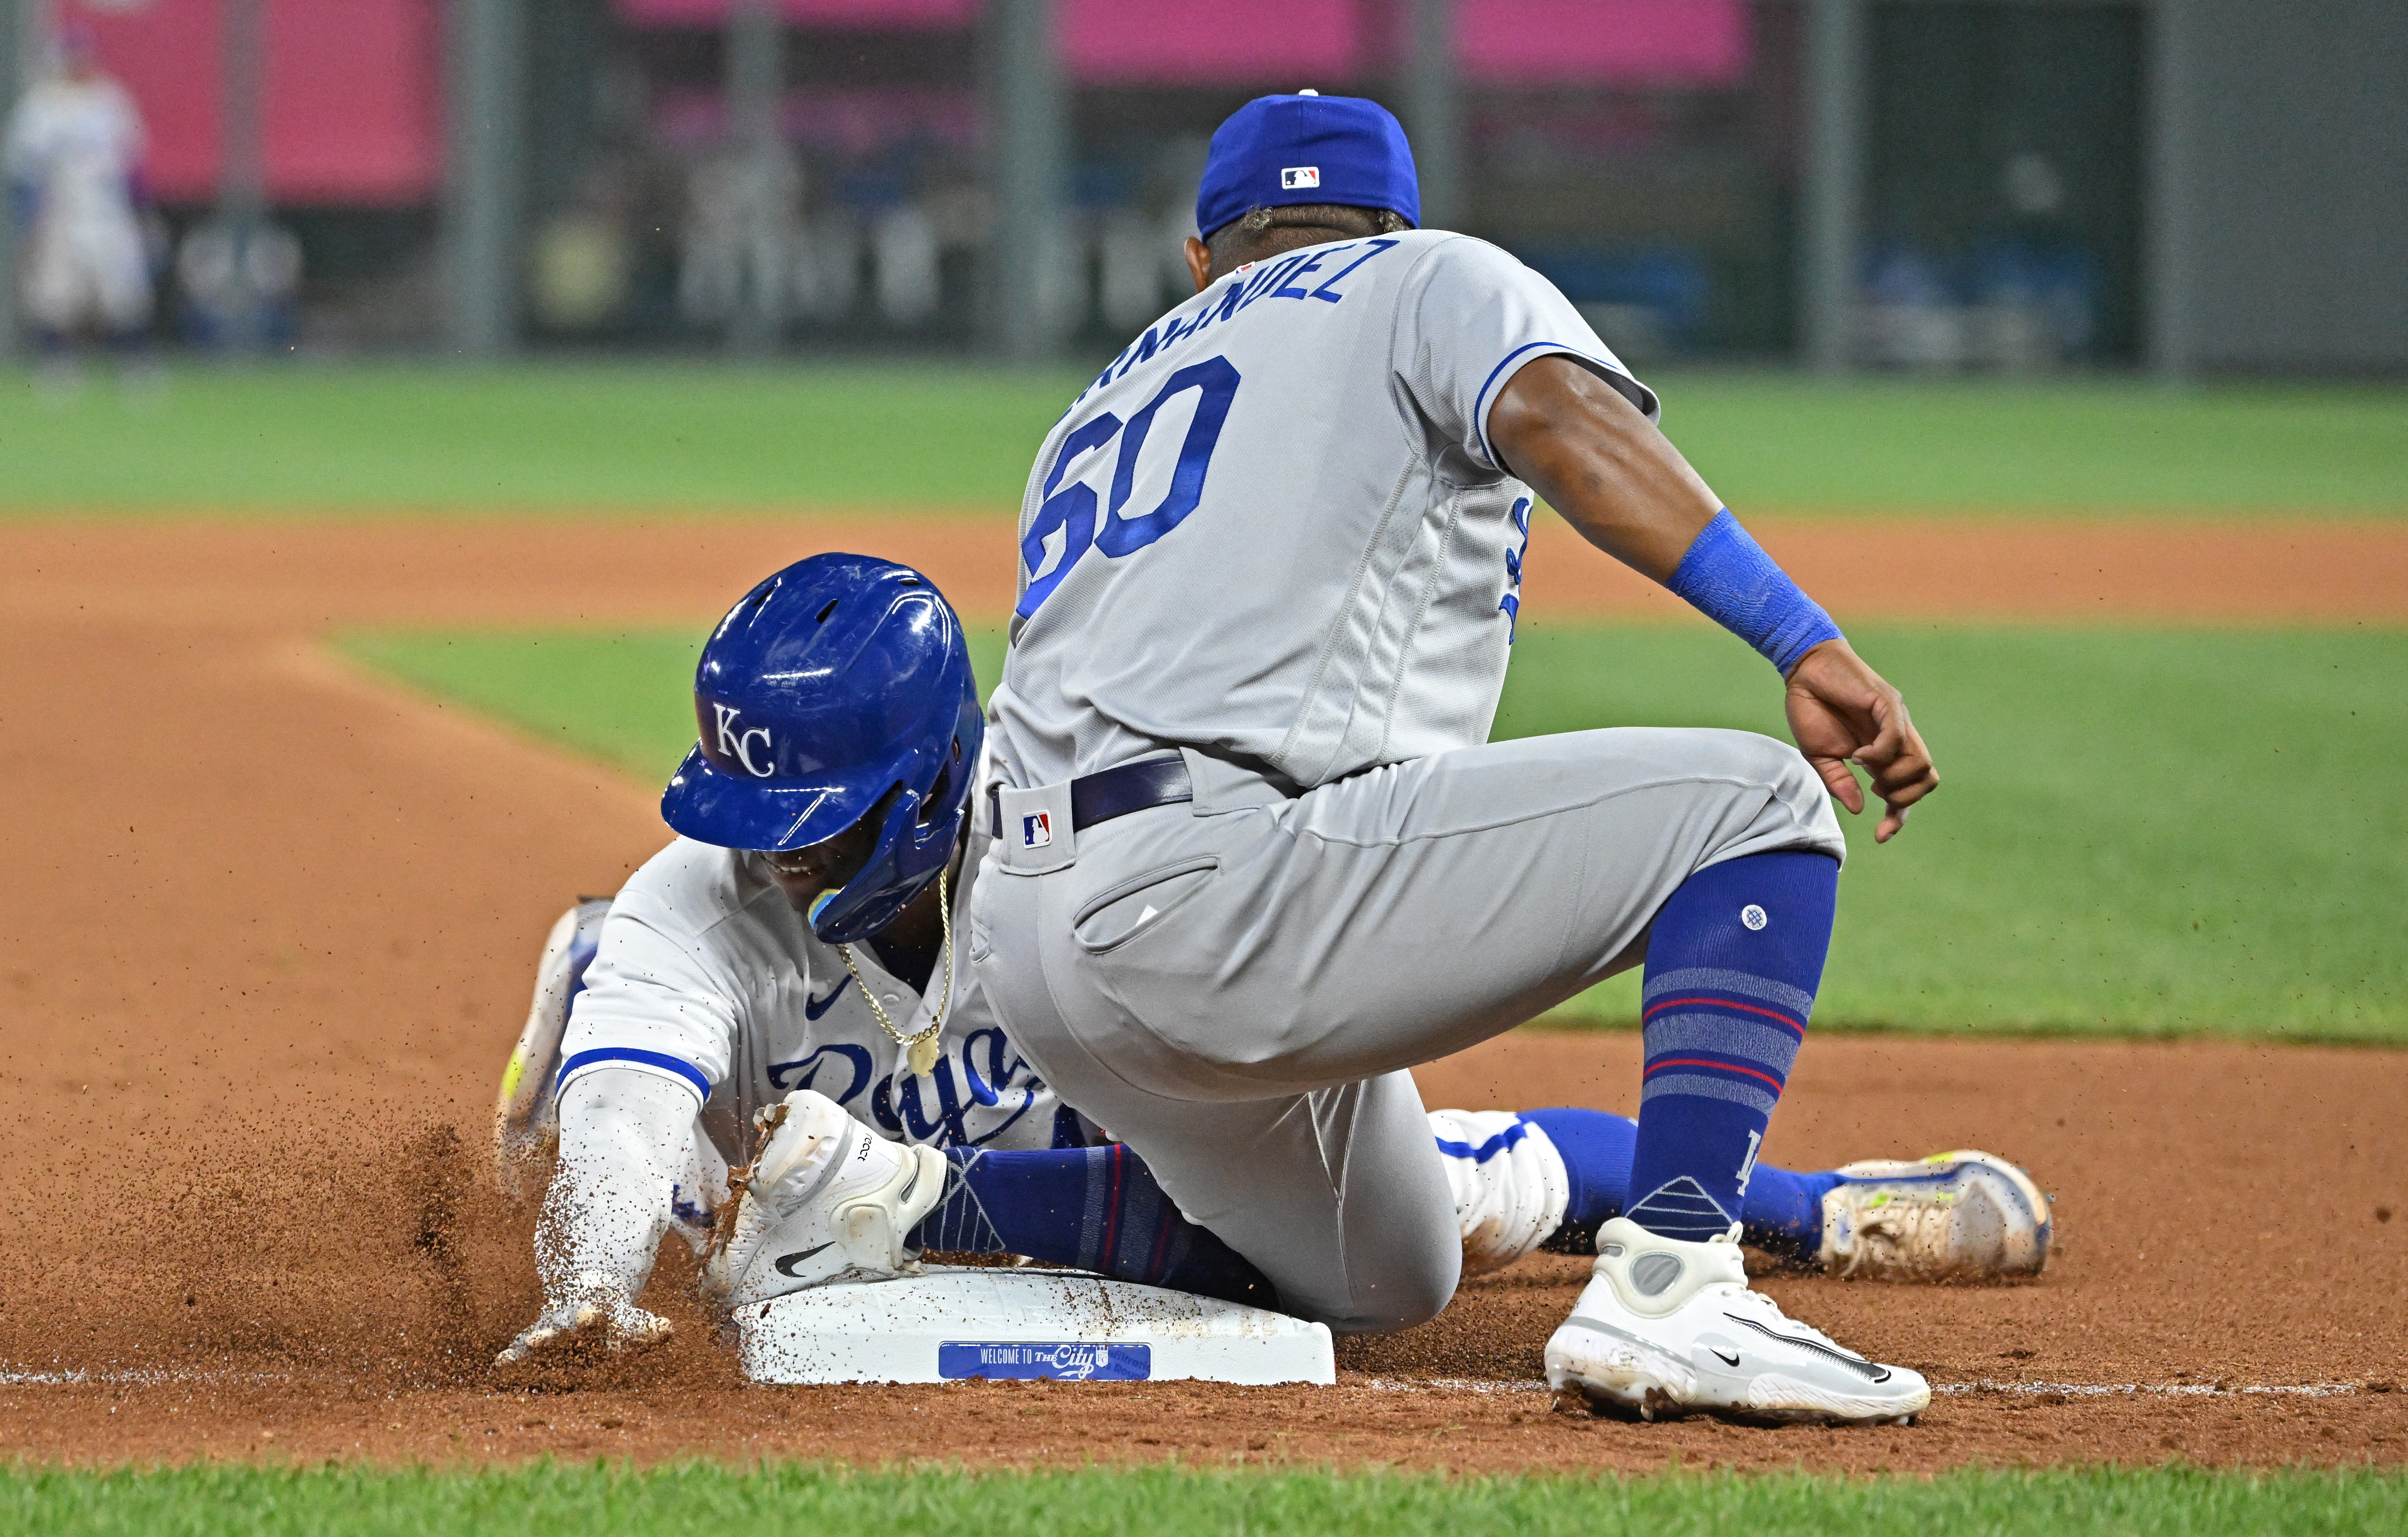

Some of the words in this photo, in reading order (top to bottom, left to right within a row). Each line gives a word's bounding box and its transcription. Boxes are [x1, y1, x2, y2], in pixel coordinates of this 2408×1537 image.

[1016, 354, 1241, 620] 60
[713, 702, 775, 777] KC
[981, 1348, 1019, 1364] WELCOME
[1022, 1349, 1032, 1364] TO
[1052, 1345, 1094, 1379] City
